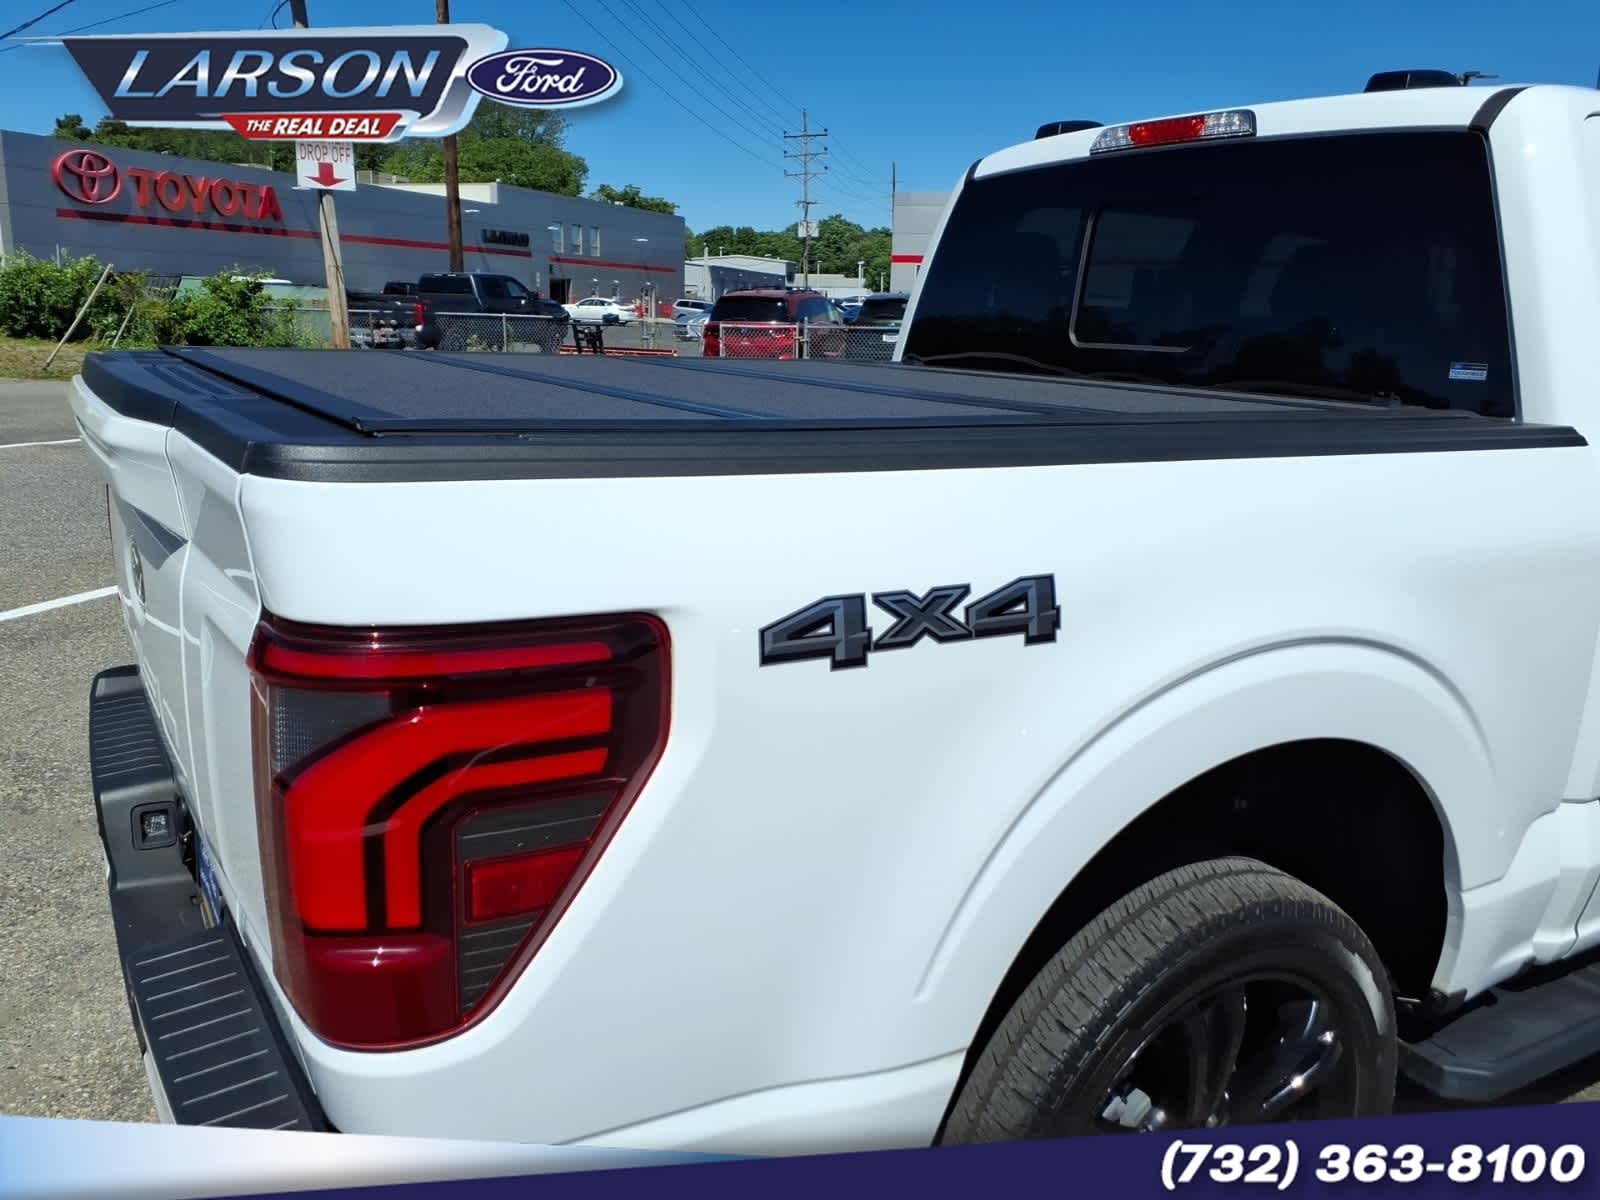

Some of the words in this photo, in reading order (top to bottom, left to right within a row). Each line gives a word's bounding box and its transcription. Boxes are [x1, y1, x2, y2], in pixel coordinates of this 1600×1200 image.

[300, 143, 329, 161] DROP
[331, 145, 351, 164] OFF
[127, 166, 284, 223] TOYOTA
